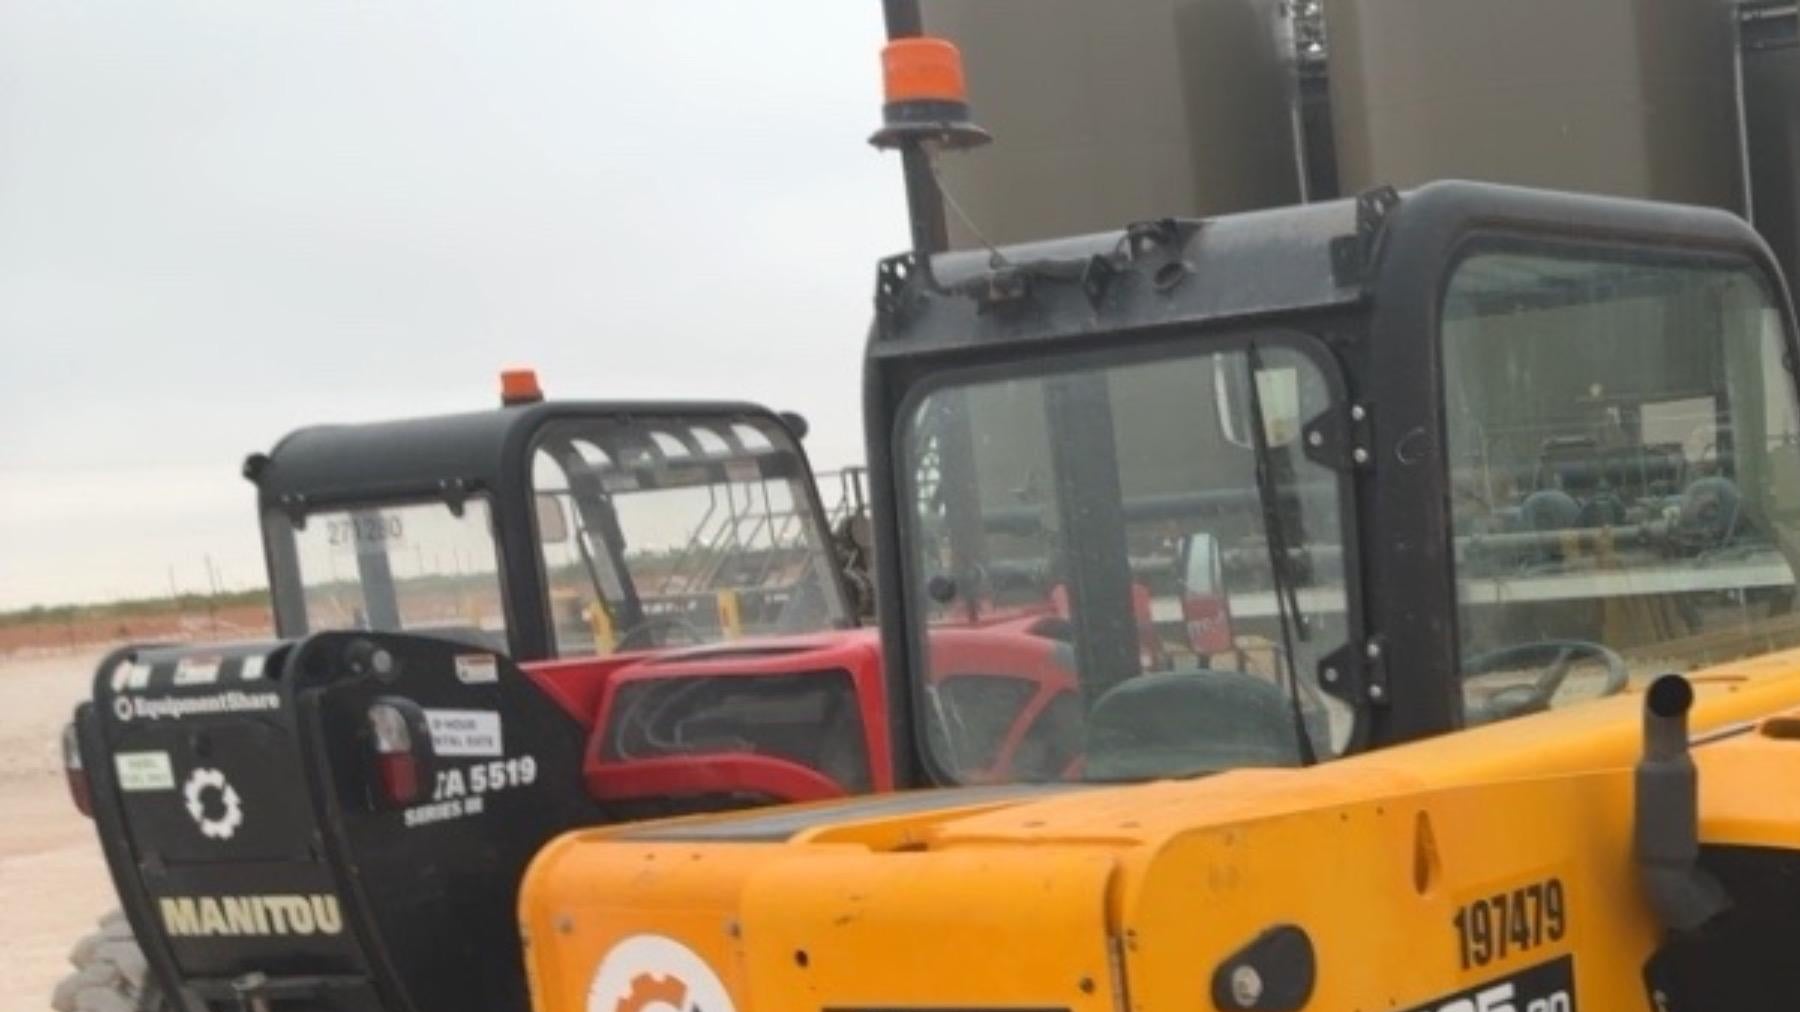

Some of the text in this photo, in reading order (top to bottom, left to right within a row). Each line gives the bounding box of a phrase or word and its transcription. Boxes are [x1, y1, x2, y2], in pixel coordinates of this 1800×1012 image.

[133, 691, 281, 720] EquipmentShare
[432, 755, 538, 801] TA 5519
[158, 892, 343, 937] MANITOU
[1453, 878, 1565, 971] 197479
